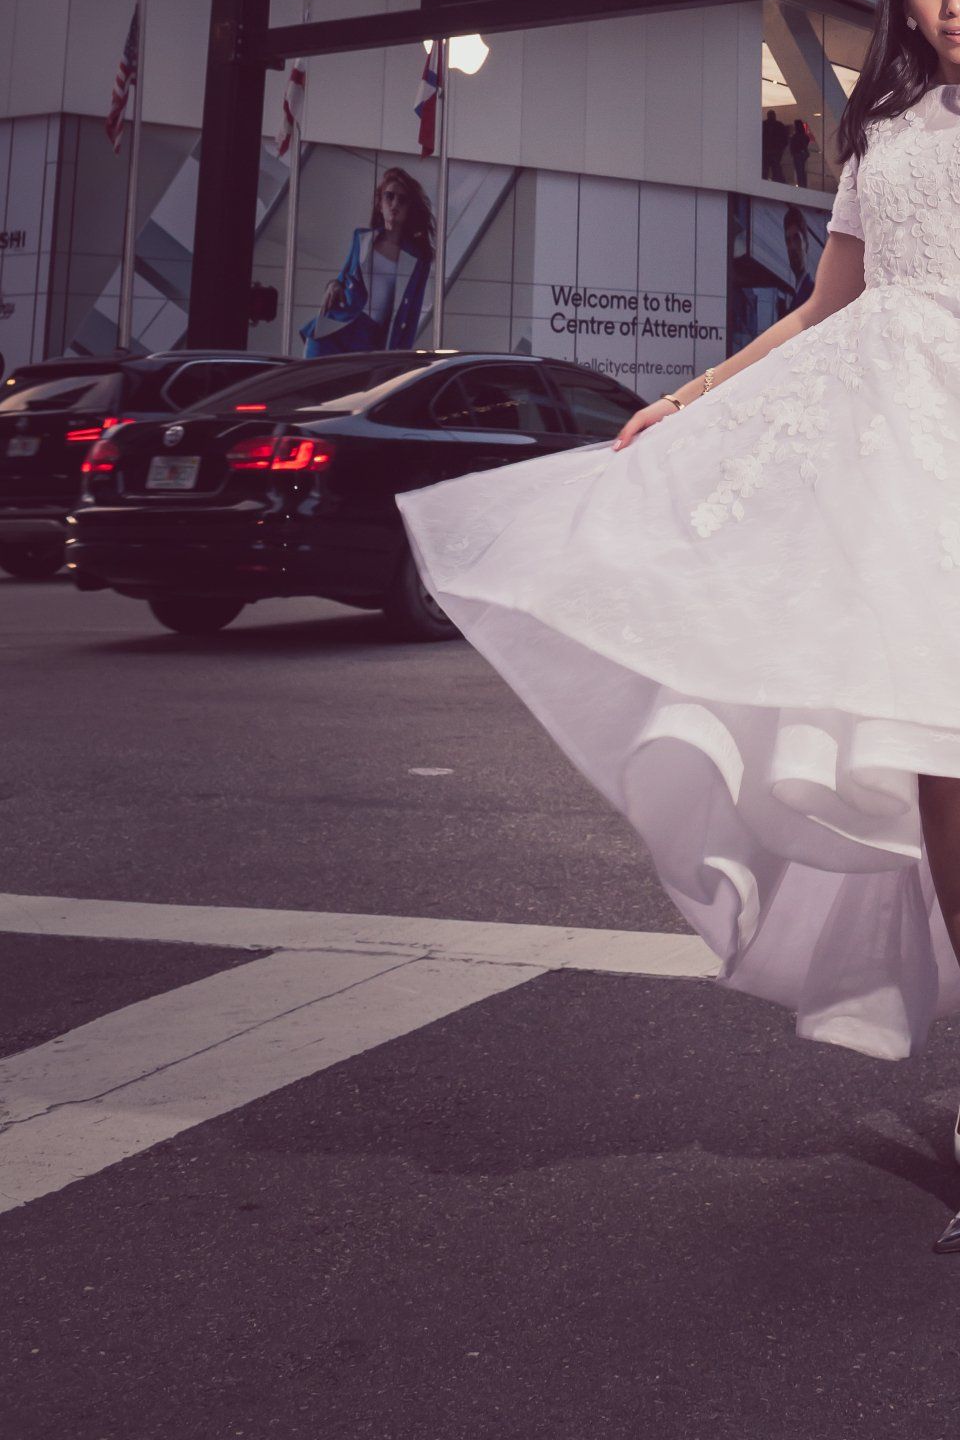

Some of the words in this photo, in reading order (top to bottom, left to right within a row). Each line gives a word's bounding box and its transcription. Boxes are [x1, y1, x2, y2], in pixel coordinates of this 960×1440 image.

[551, 285, 638, 310] Welcome
[643, 293, 660, 311] to
[664, 293, 692, 313] the
[550, 312, 615, 336] Centre
[619, 318, 638, 336] of
[641, 316, 723, 341] Attention.
